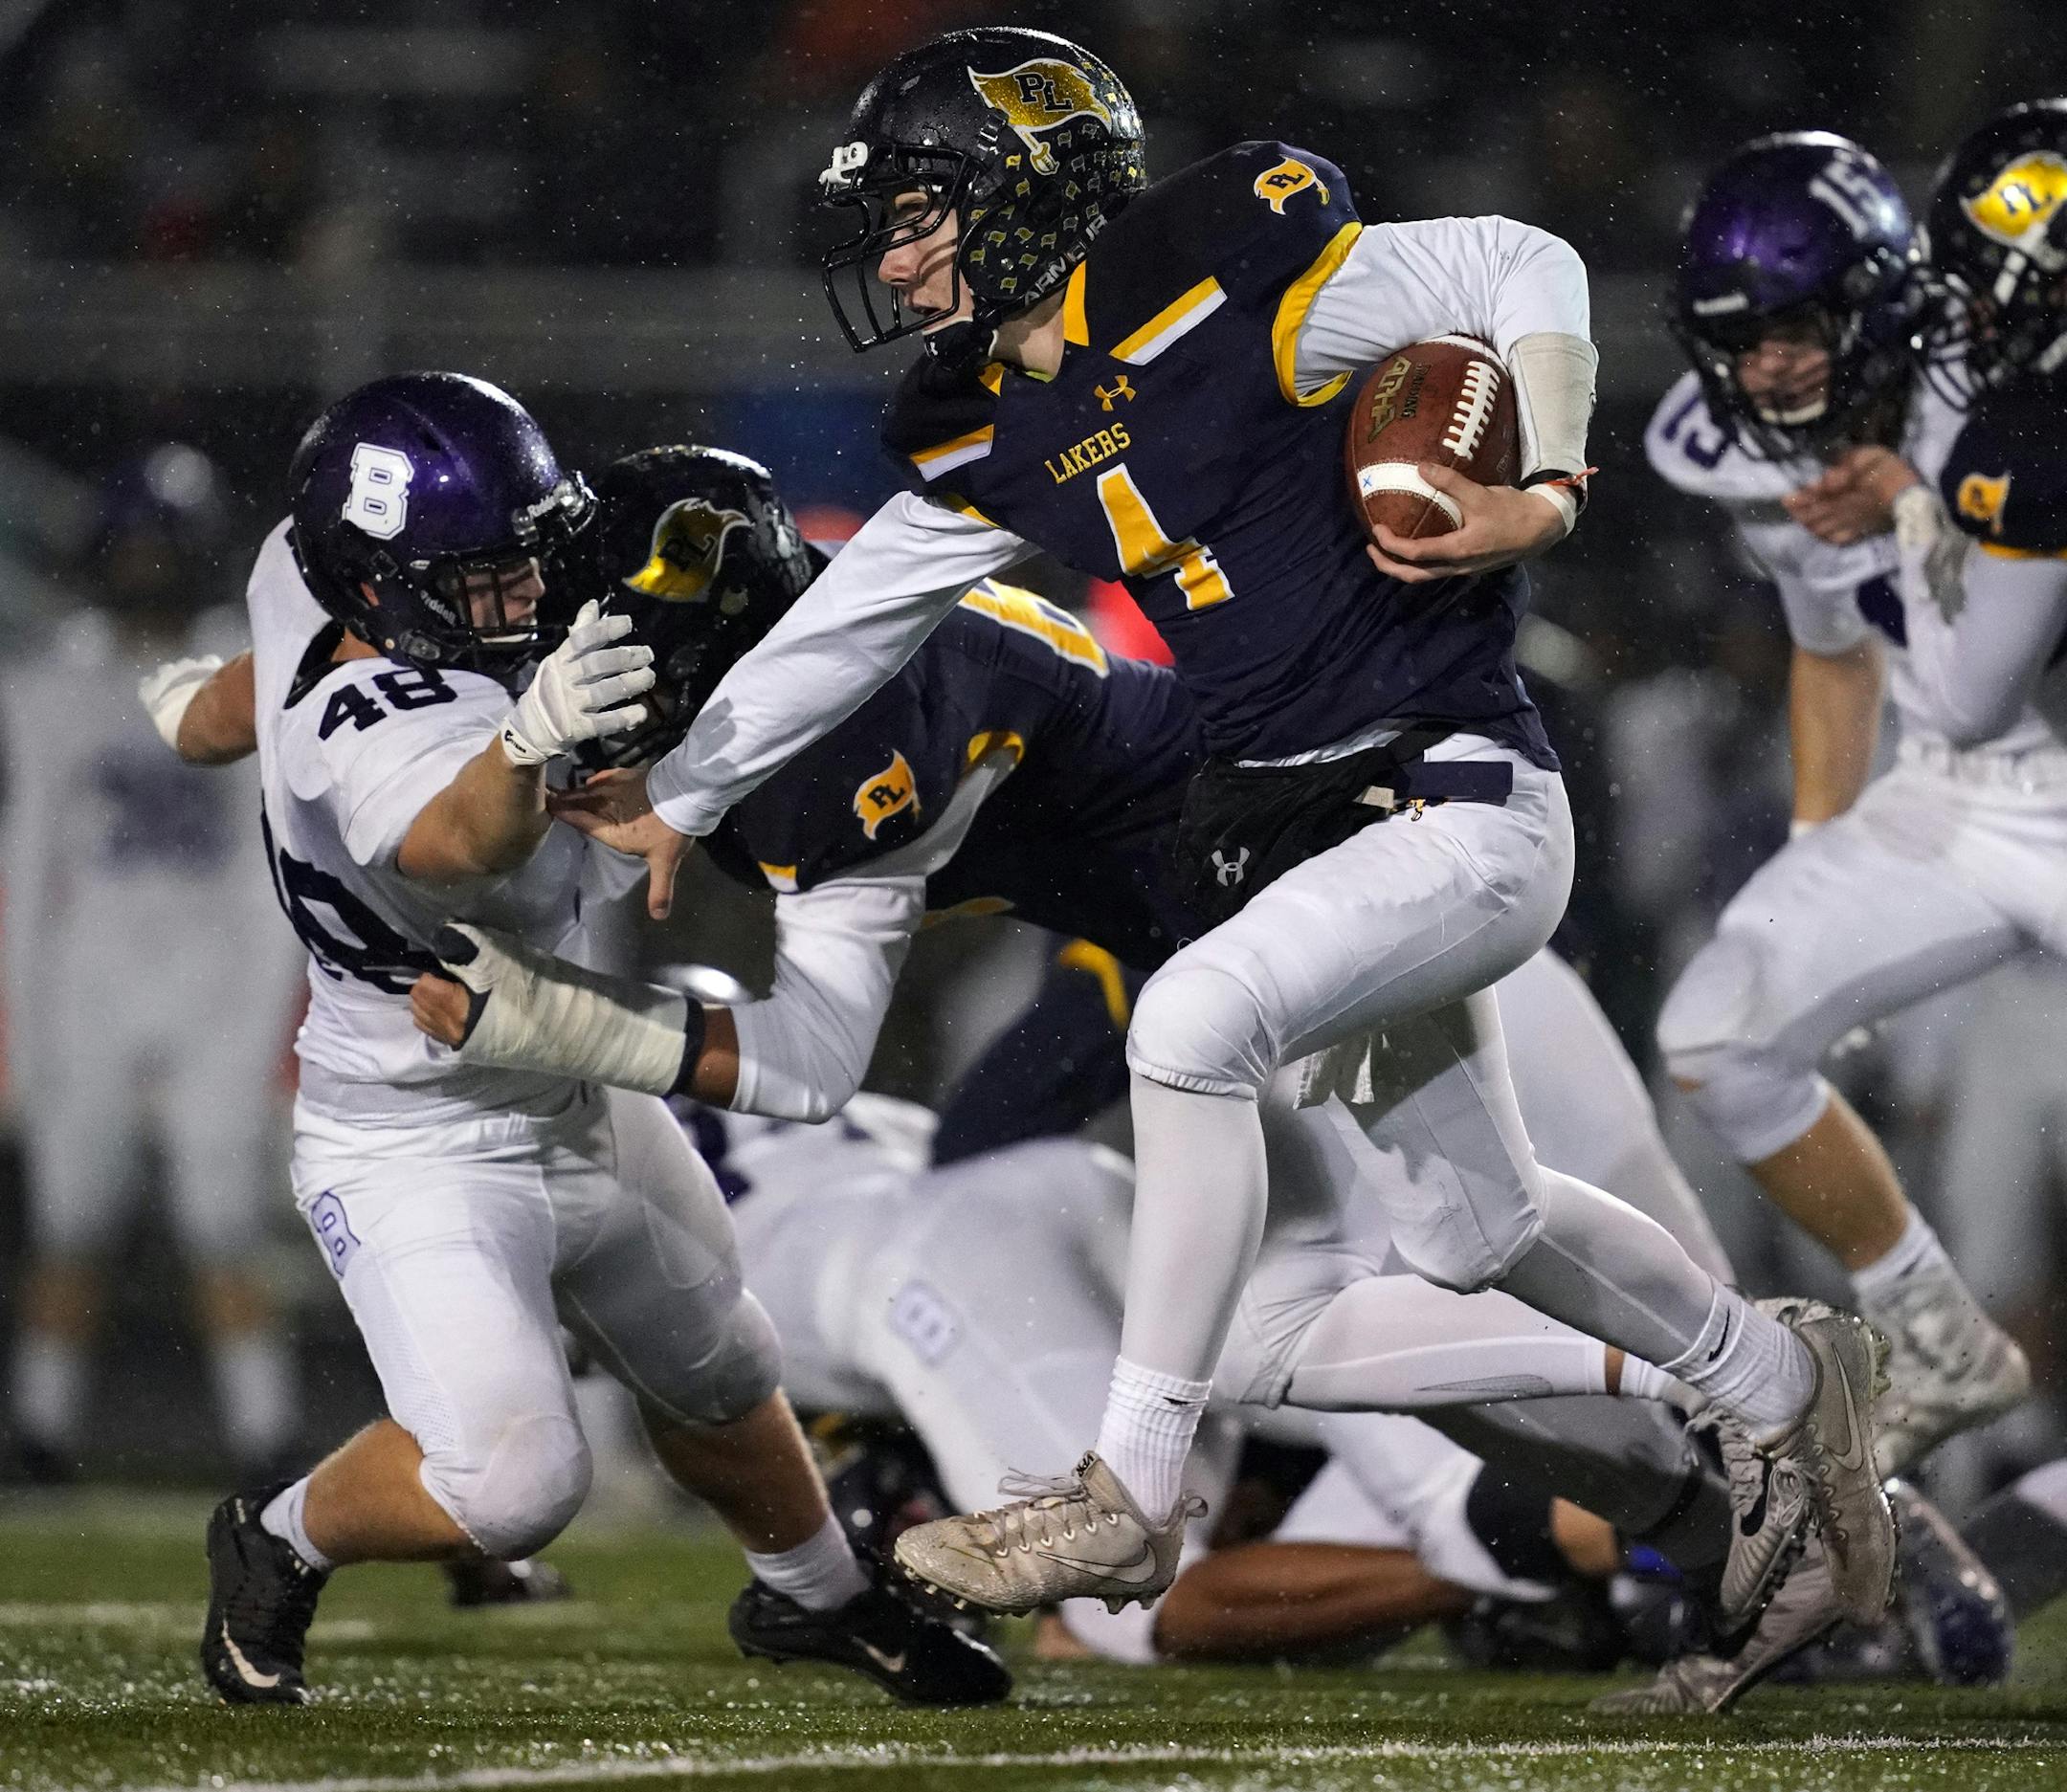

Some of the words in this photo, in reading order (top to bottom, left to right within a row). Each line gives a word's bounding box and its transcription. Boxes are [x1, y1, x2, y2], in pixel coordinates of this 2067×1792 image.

[1013, 72, 1074, 112] PL
[1265, 173, 1306, 189] PL
[1044, 422, 1132, 484] LAKERS
[342, 442, 414, 541] B
[1097, 462, 1236, 610] 4
[319, 669, 458, 741] 48
[867, 784, 906, 809] PL
